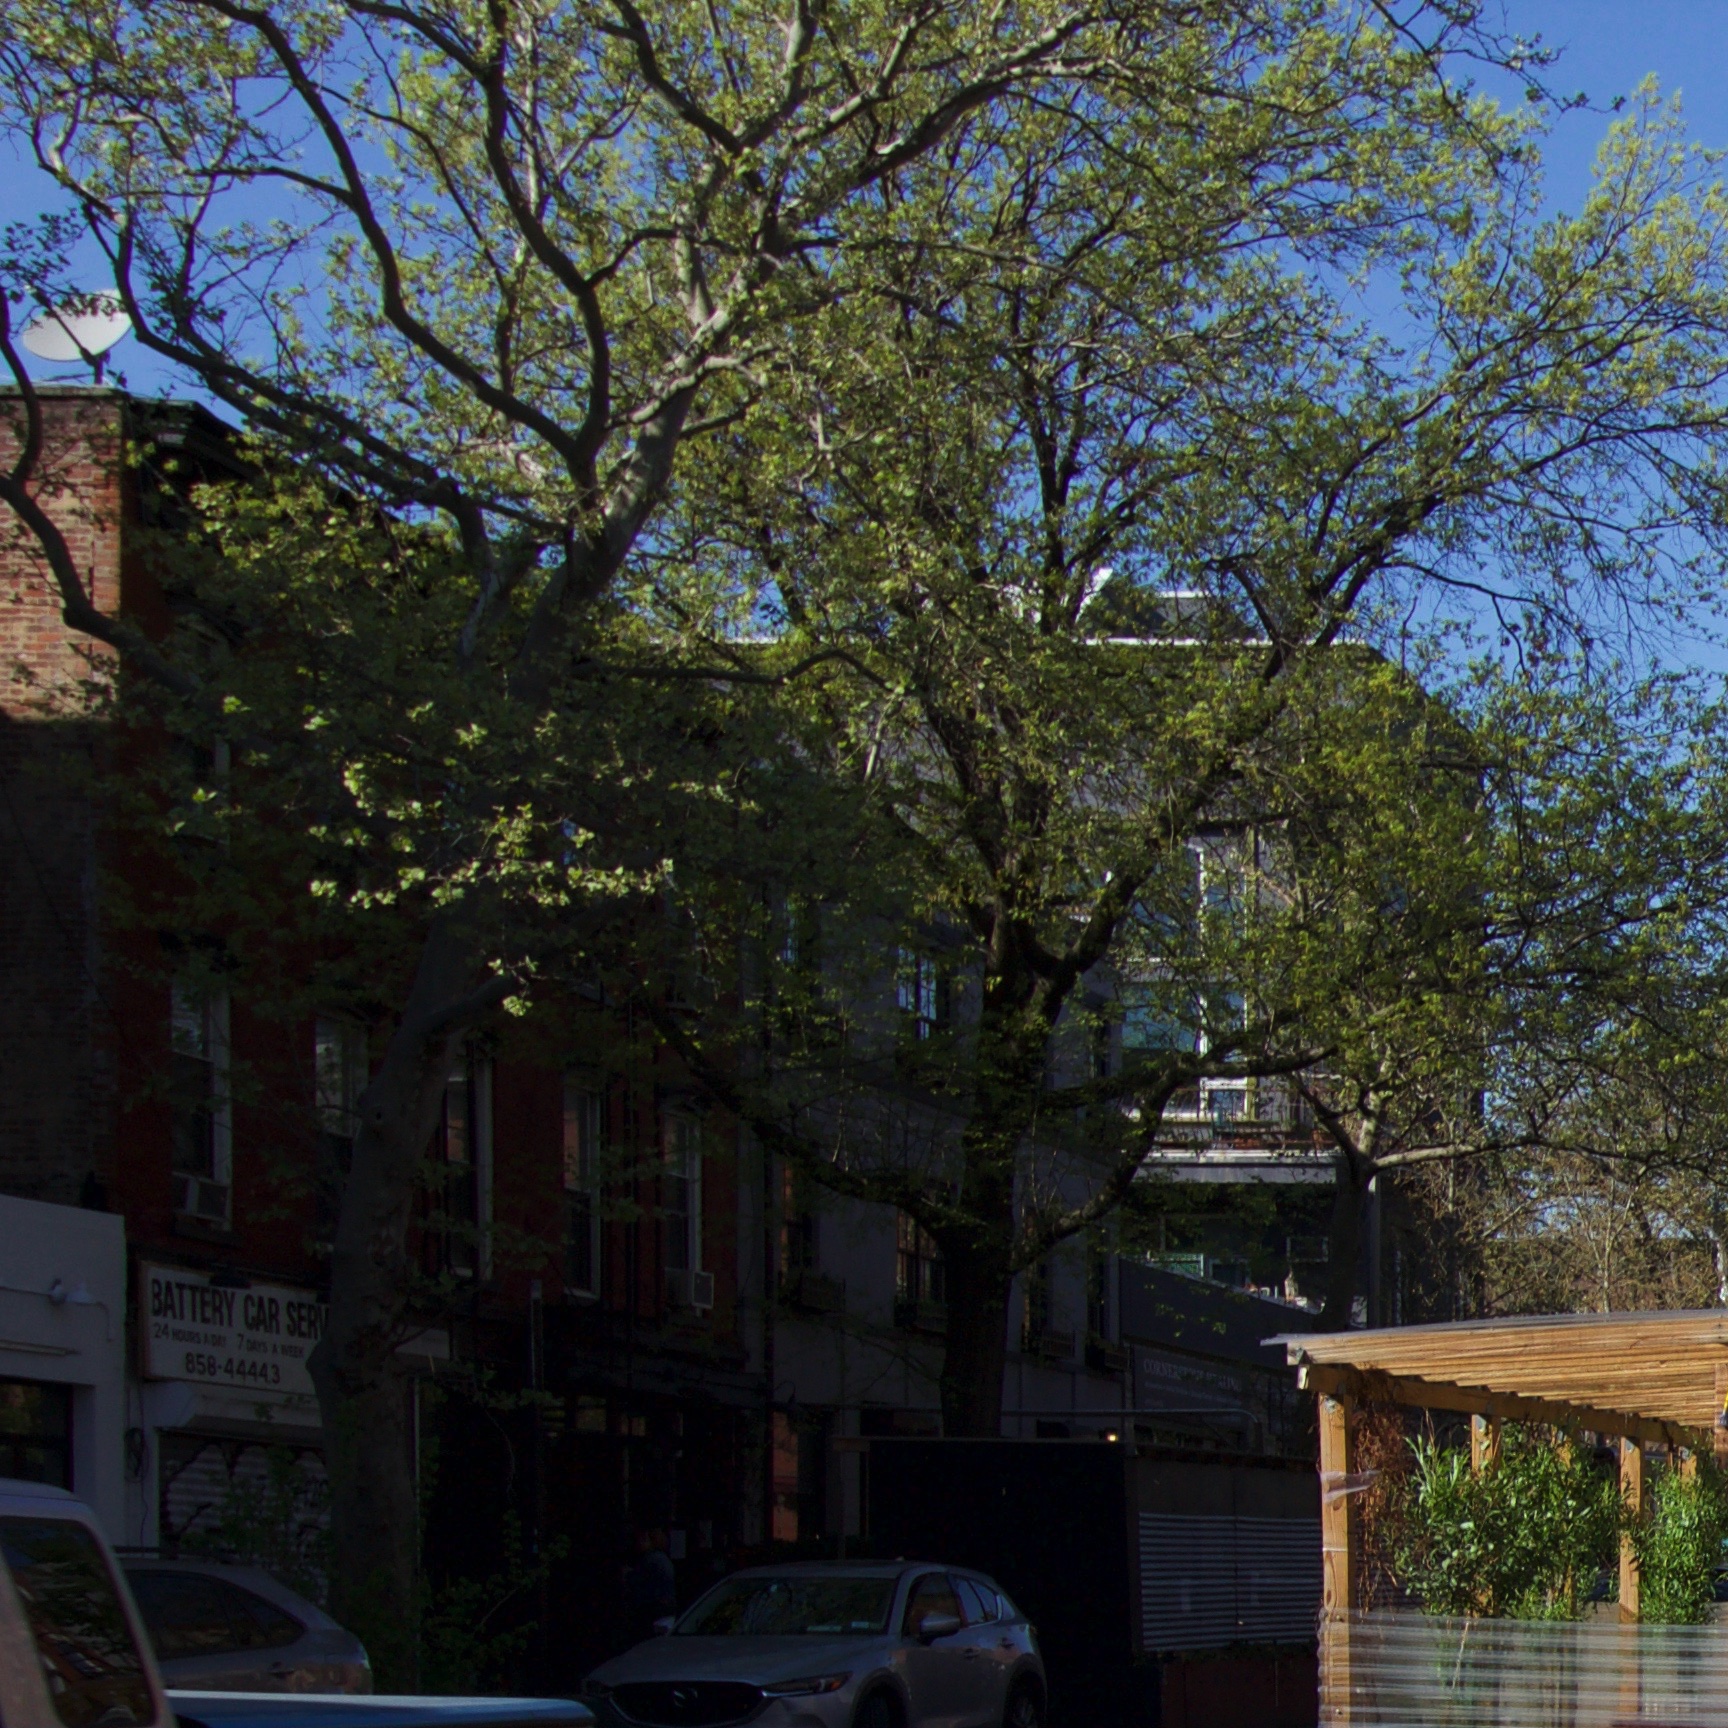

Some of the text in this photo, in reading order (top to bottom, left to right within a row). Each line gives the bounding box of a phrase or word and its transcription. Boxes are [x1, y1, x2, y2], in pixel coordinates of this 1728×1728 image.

[151, 1278, 330, 1340] BATTERY CAR SERV
[153, 1323, 170, 1339] 24
[237, 1333, 245, 1350] 7
